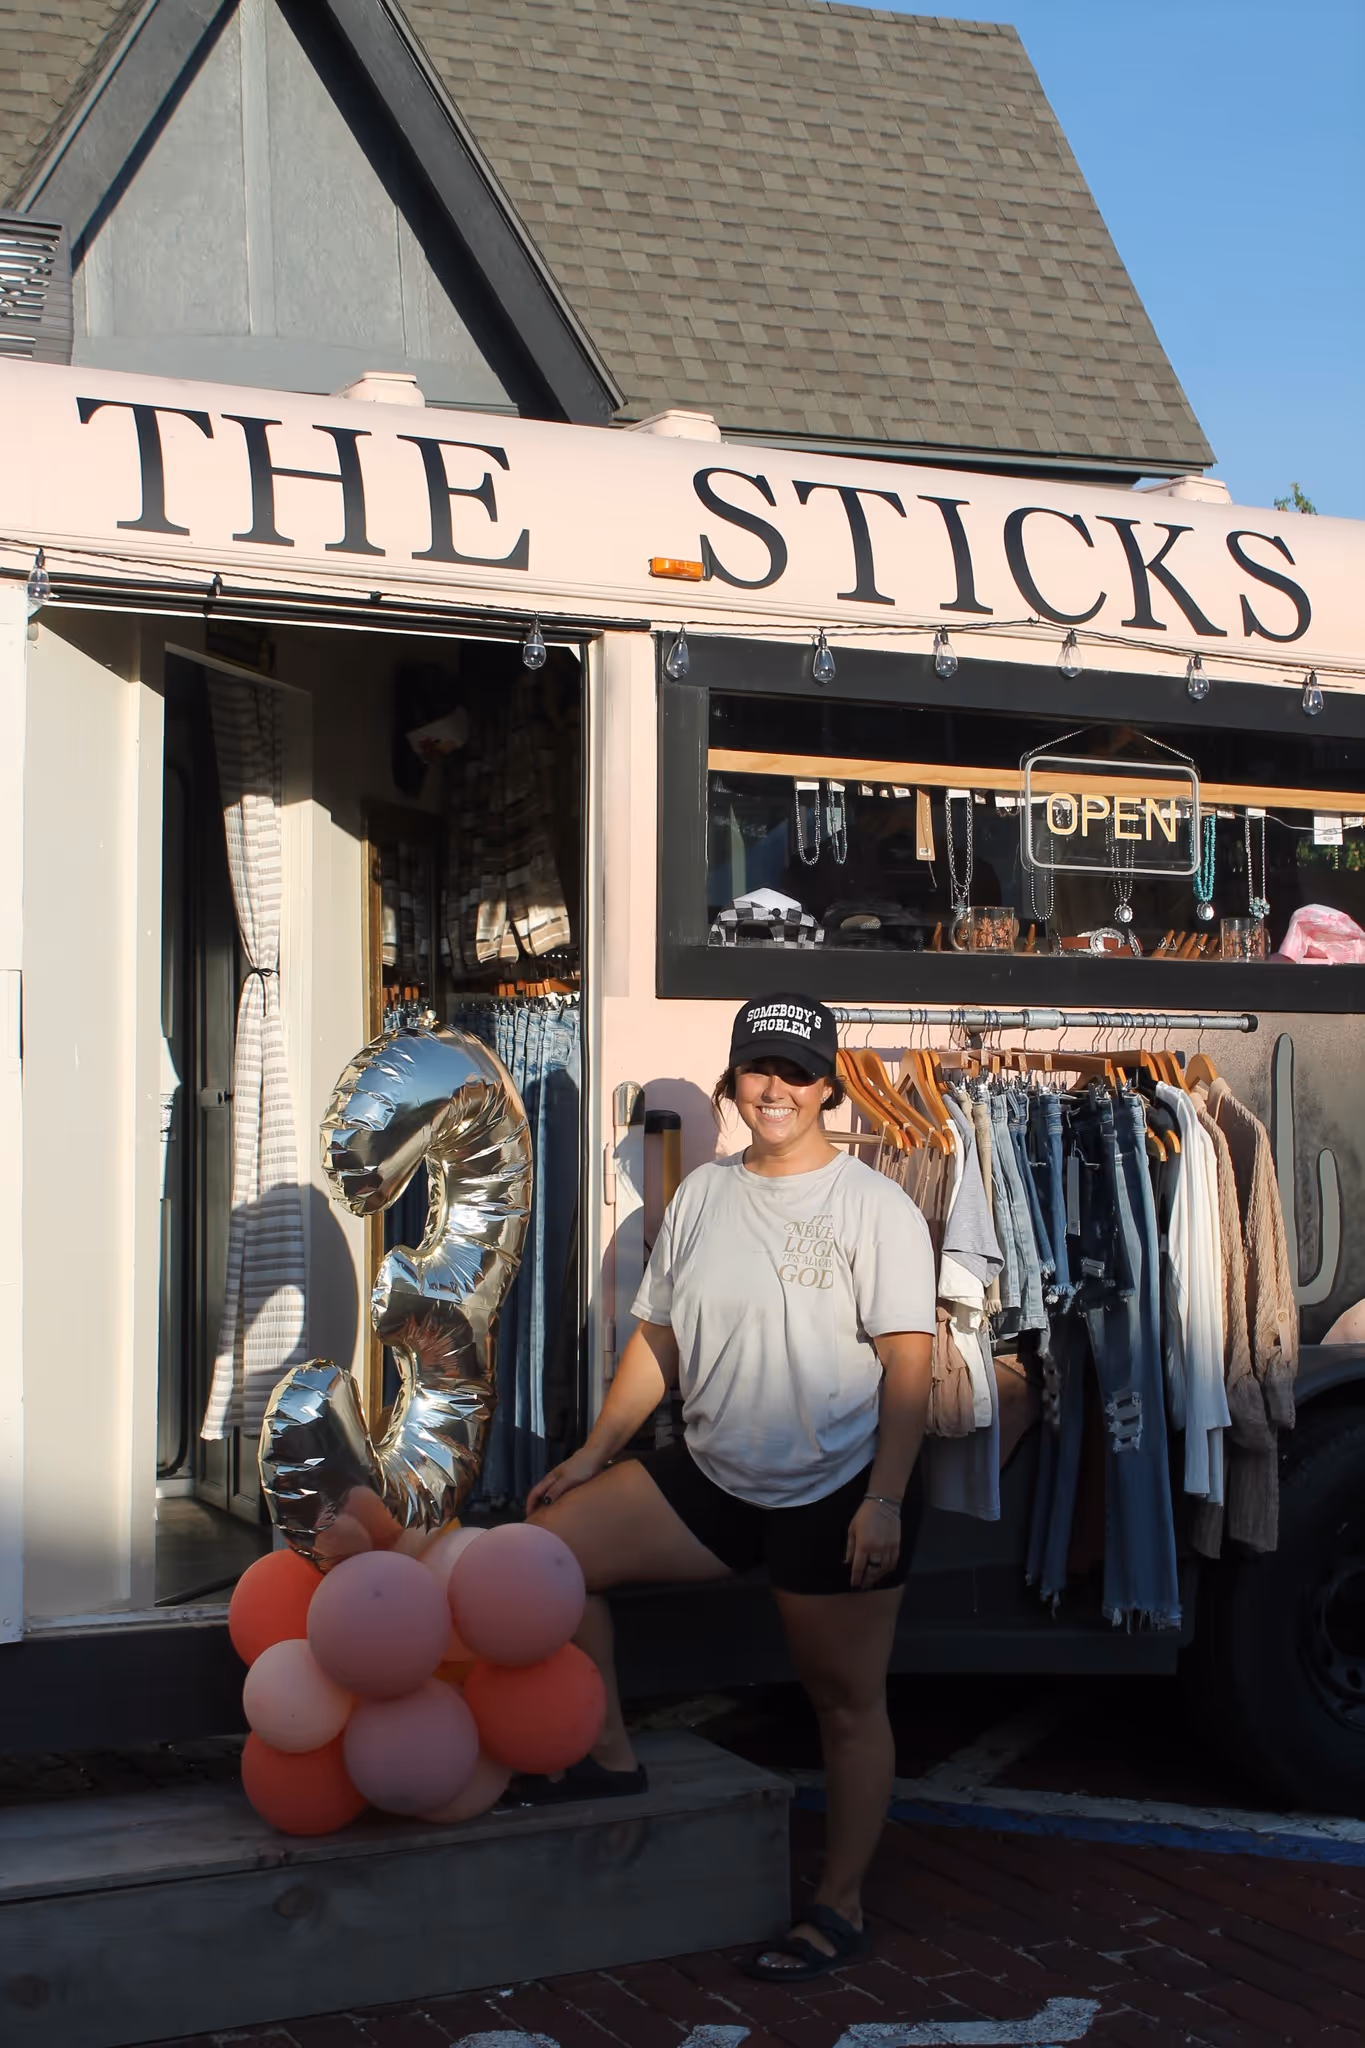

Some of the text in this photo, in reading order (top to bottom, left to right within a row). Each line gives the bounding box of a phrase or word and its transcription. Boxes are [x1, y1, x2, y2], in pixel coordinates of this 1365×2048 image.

[76, 396, 1312, 643] THE STICKS
[1046, 792, 1177, 843] OPEN
[747, 1004, 822, 1029] SOMEBODY'S
[752, 1019, 812, 1039] PROBLEM
[778, 1263, 834, 1290] GOD
